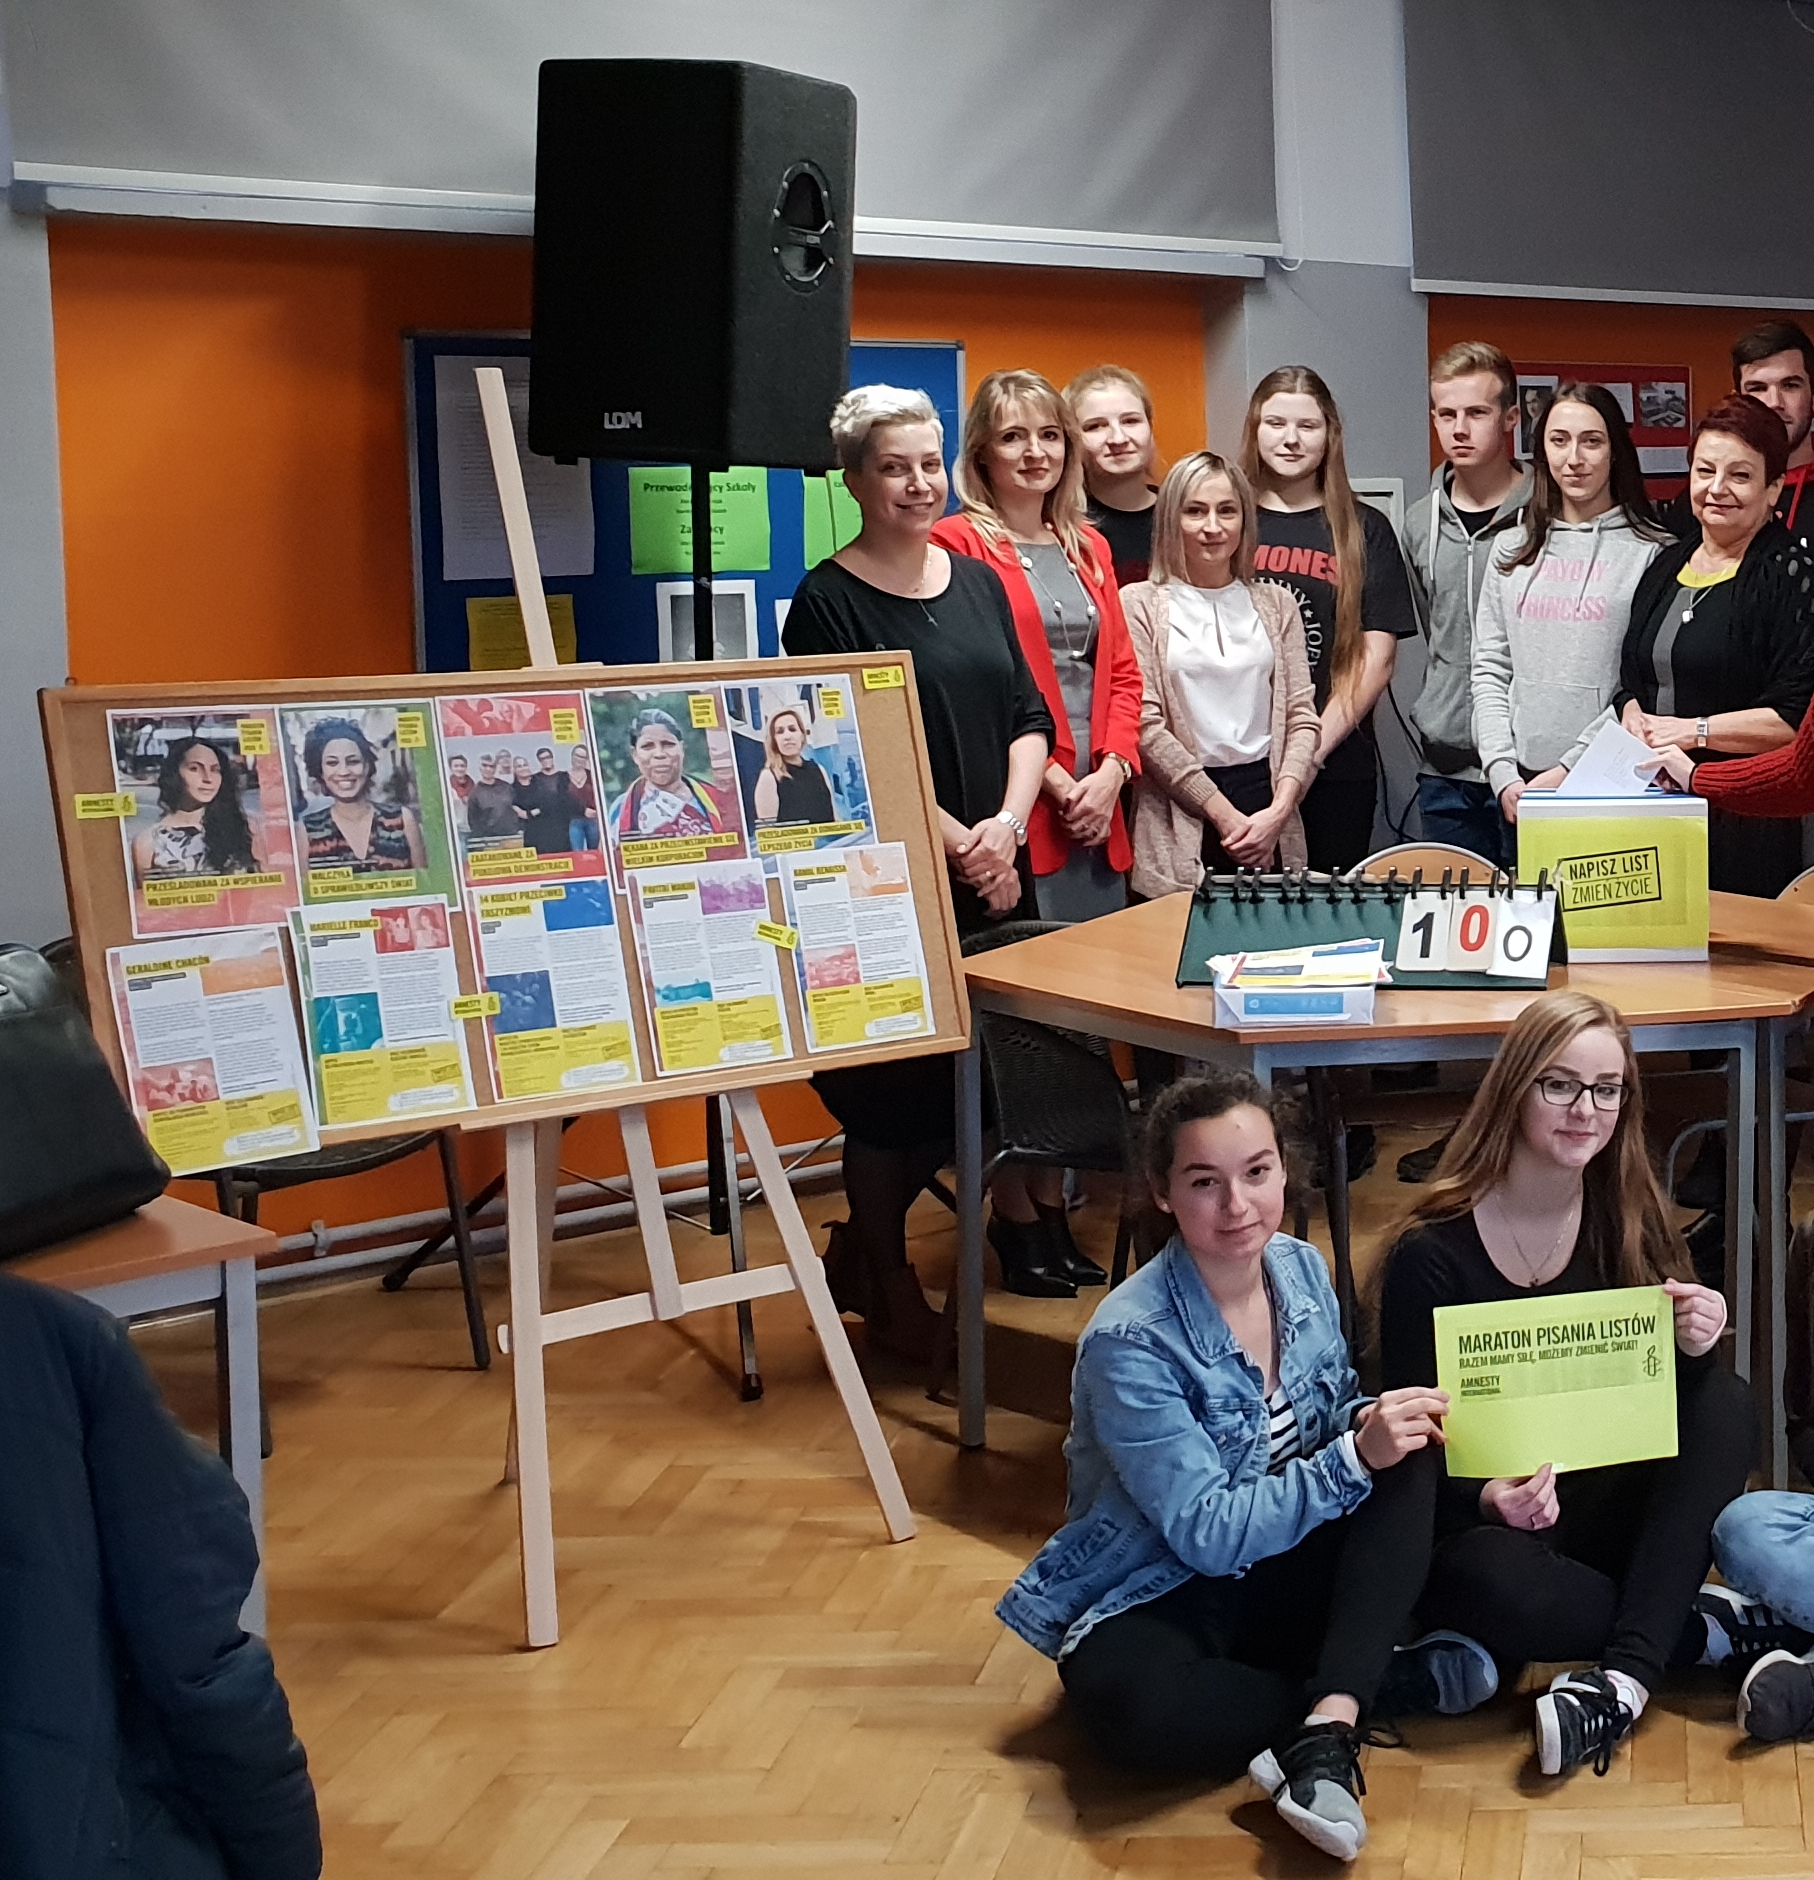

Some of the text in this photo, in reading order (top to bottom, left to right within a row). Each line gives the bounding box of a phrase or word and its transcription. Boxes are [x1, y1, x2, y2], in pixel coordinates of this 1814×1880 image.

[1569, 853, 1650, 881] NAPISZ LIST
[1571, 878, 1612, 905] ZMIEŃ
[1458, 1313, 1656, 1355] MARATON PISANIA LISTÓW
[1459, 1355, 1488, 1369] RAZEM
[1460, 1375, 1501, 1388] AMNESTY
